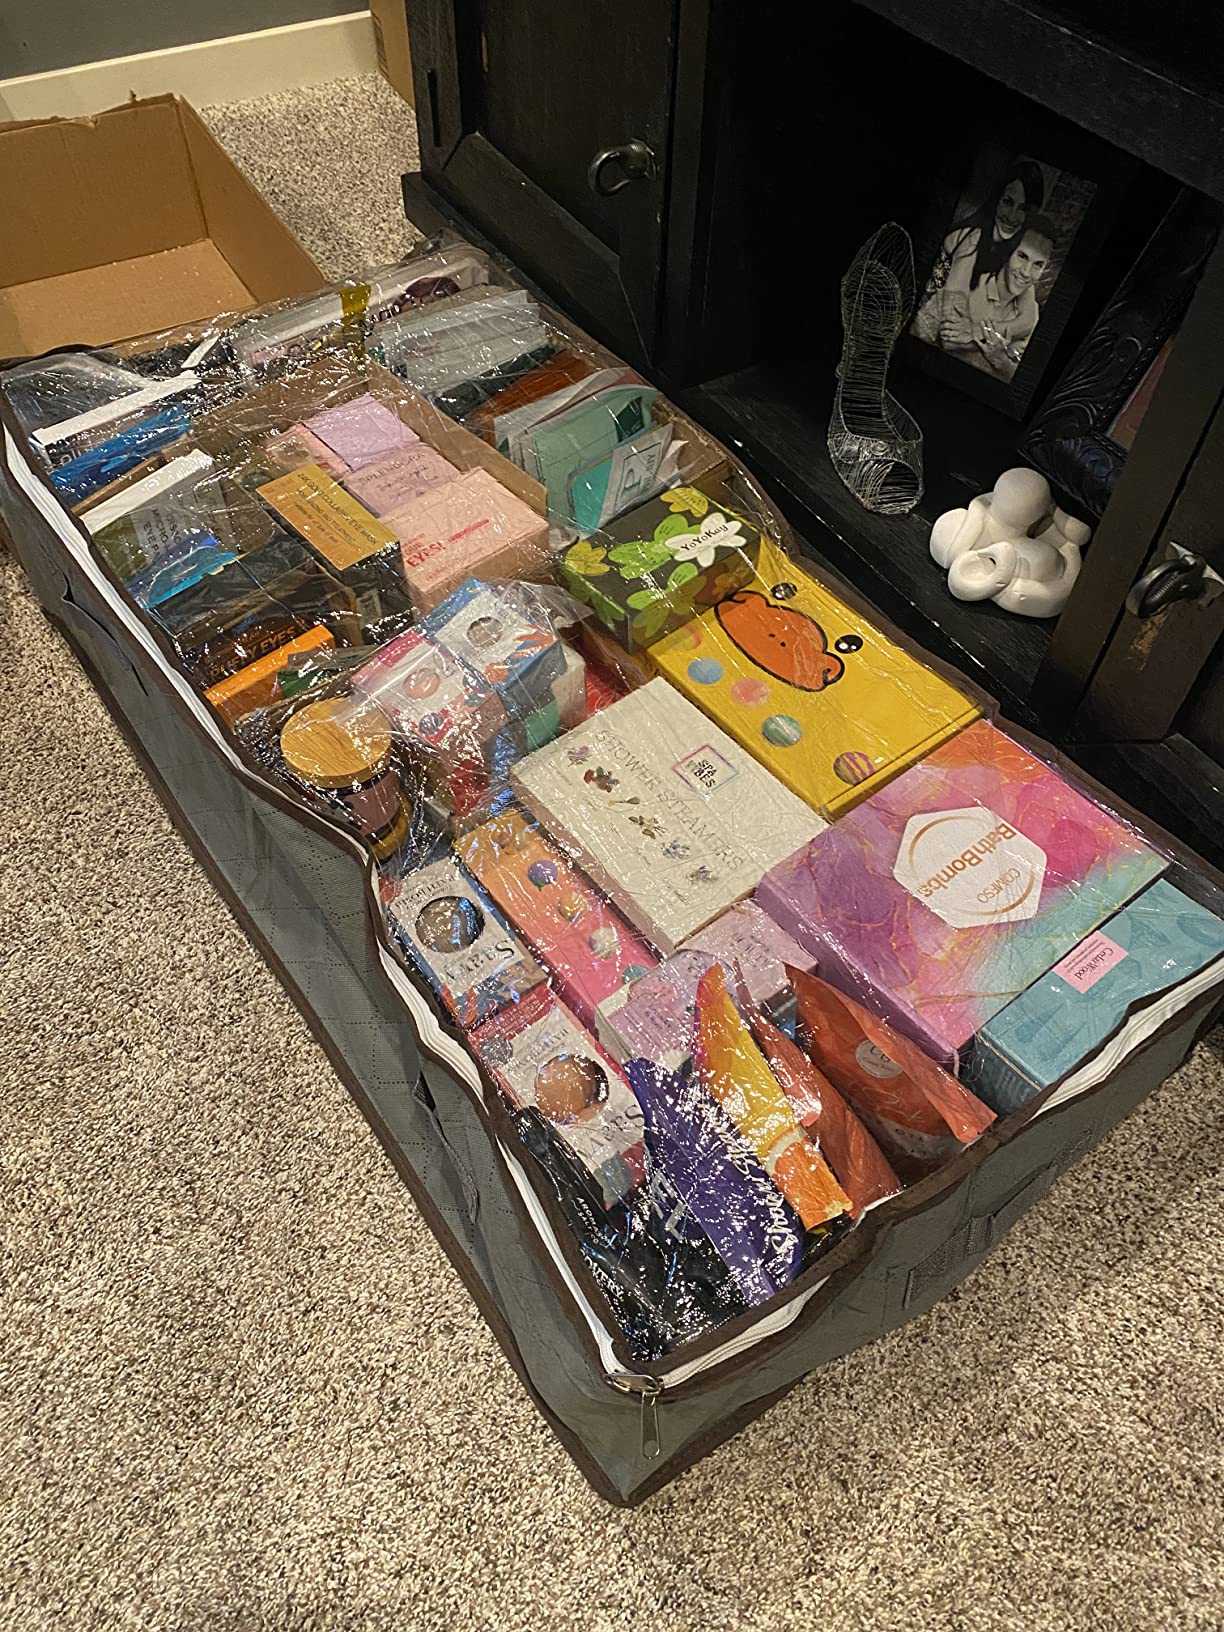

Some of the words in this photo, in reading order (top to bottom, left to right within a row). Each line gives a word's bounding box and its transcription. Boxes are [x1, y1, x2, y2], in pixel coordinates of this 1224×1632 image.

[680, 524, 728, 551] YoYoKay
[702, 760, 717, 777] SPA
[593, 728, 663, 791] SHOWER
[656, 787, 746, 871] STEAMERS
